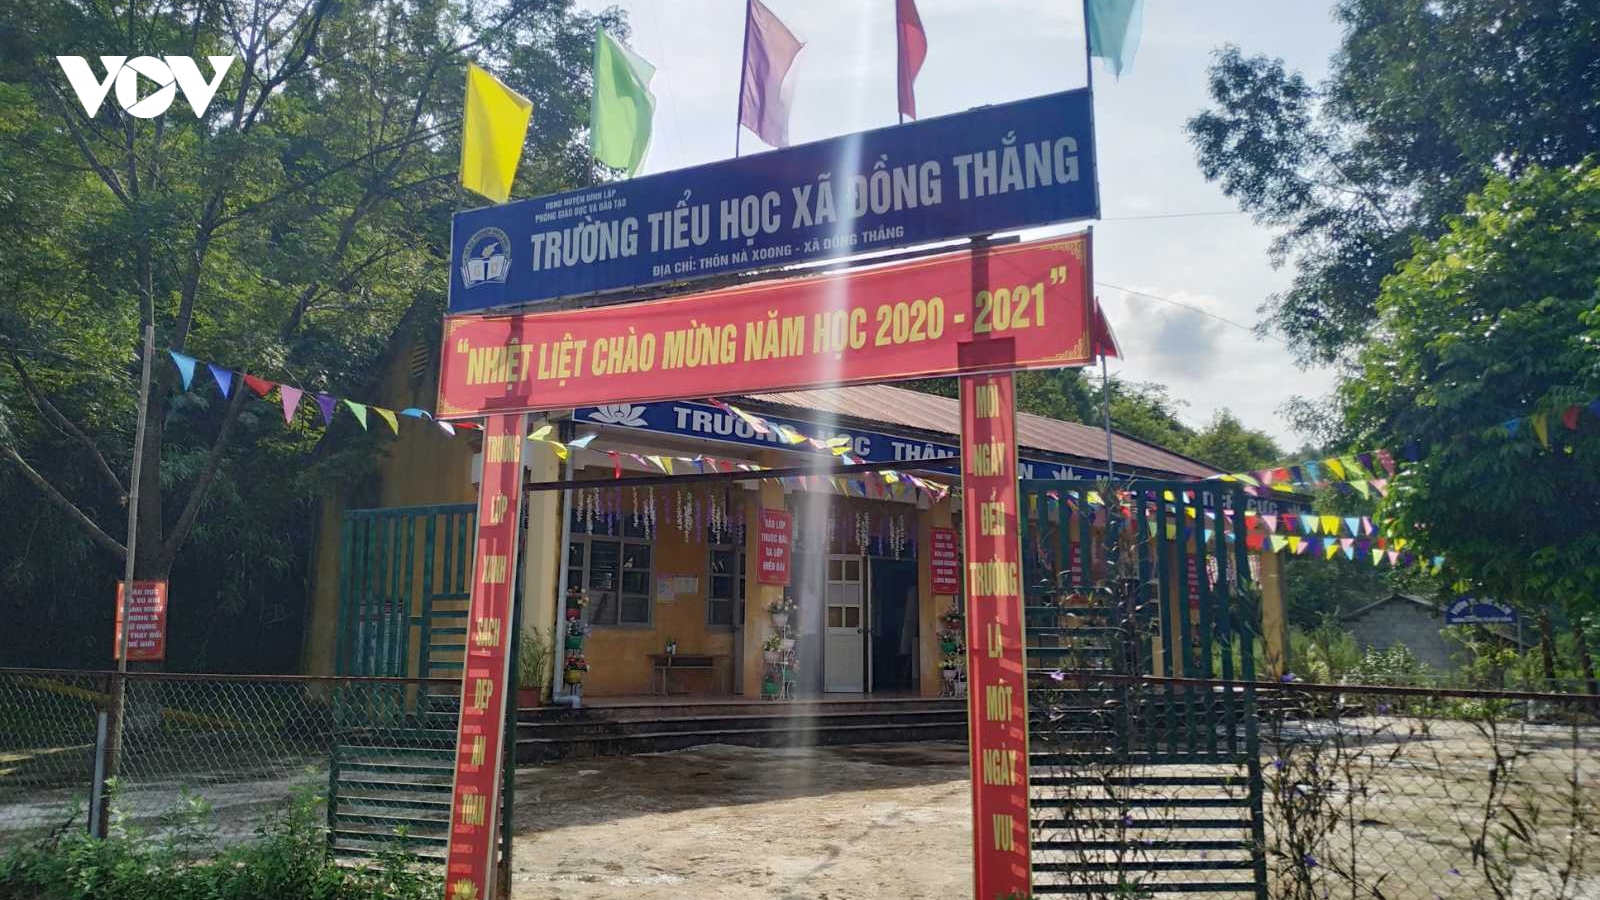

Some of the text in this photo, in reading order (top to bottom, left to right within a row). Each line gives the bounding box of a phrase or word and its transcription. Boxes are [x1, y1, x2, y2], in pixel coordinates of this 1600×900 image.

[530, 215, 638, 272] TRƯỜNG
[648, 188, 710, 252] TIỂU
[720, 190, 780, 245] HỌC
[791, 172, 837, 229] XÃ
[849, 154, 943, 218] ĐỒNG
[953, 131, 1080, 200] THẮNG
[535, 210, 557, 223] PHÒNG
[558, 207, 573, 219] GIÁO
[574, 205, 588, 217] DỤC
[599, 199, 612, 211] ĐÀO
[614, 197, 627, 210] TẠO
[652, 263, 672, 277] ĐỊA
[674, 258, 697, 273] CHỈ:
[700, 254, 729, 270] THÔN
[731, 246, 748, 263] NÀ
[751, 245, 792, 261] XOONG
[803, 237, 821, 253] XÃ
[862, 225, 905, 243] THẮNG
[537, 333, 588, 387] LIỆT
[591, 326, 656, 377] CHÀO
[662, 319, 737, 370] MỪNG
[743, 309, 805, 362] NĂM
[813, 307, 867, 361] HỌC
[874, 297, 945, 347] 2020
[975, 374, 1000, 418] MỖI
[487, 428, 521, 463] TRƯỜNG
[972, 434, 1005, 477] NGÀY
[490, 489, 508, 525] LỚP
[980, 487, 1006, 536] ĐẾN
[481, 554, 507, 584] XANH
[969, 553, 1018, 597] TRƯỜNG
[987, 614, 1004, 658] LÀ
[474, 678, 494, 714] ĐẸP
[985, 677, 1013, 730] MỘT
[471, 735, 487, 766] AN
[983, 741, 1017, 786] NGÀY
[462, 791, 486, 827] TOÀN
[992, 813, 1014, 850] VUI
